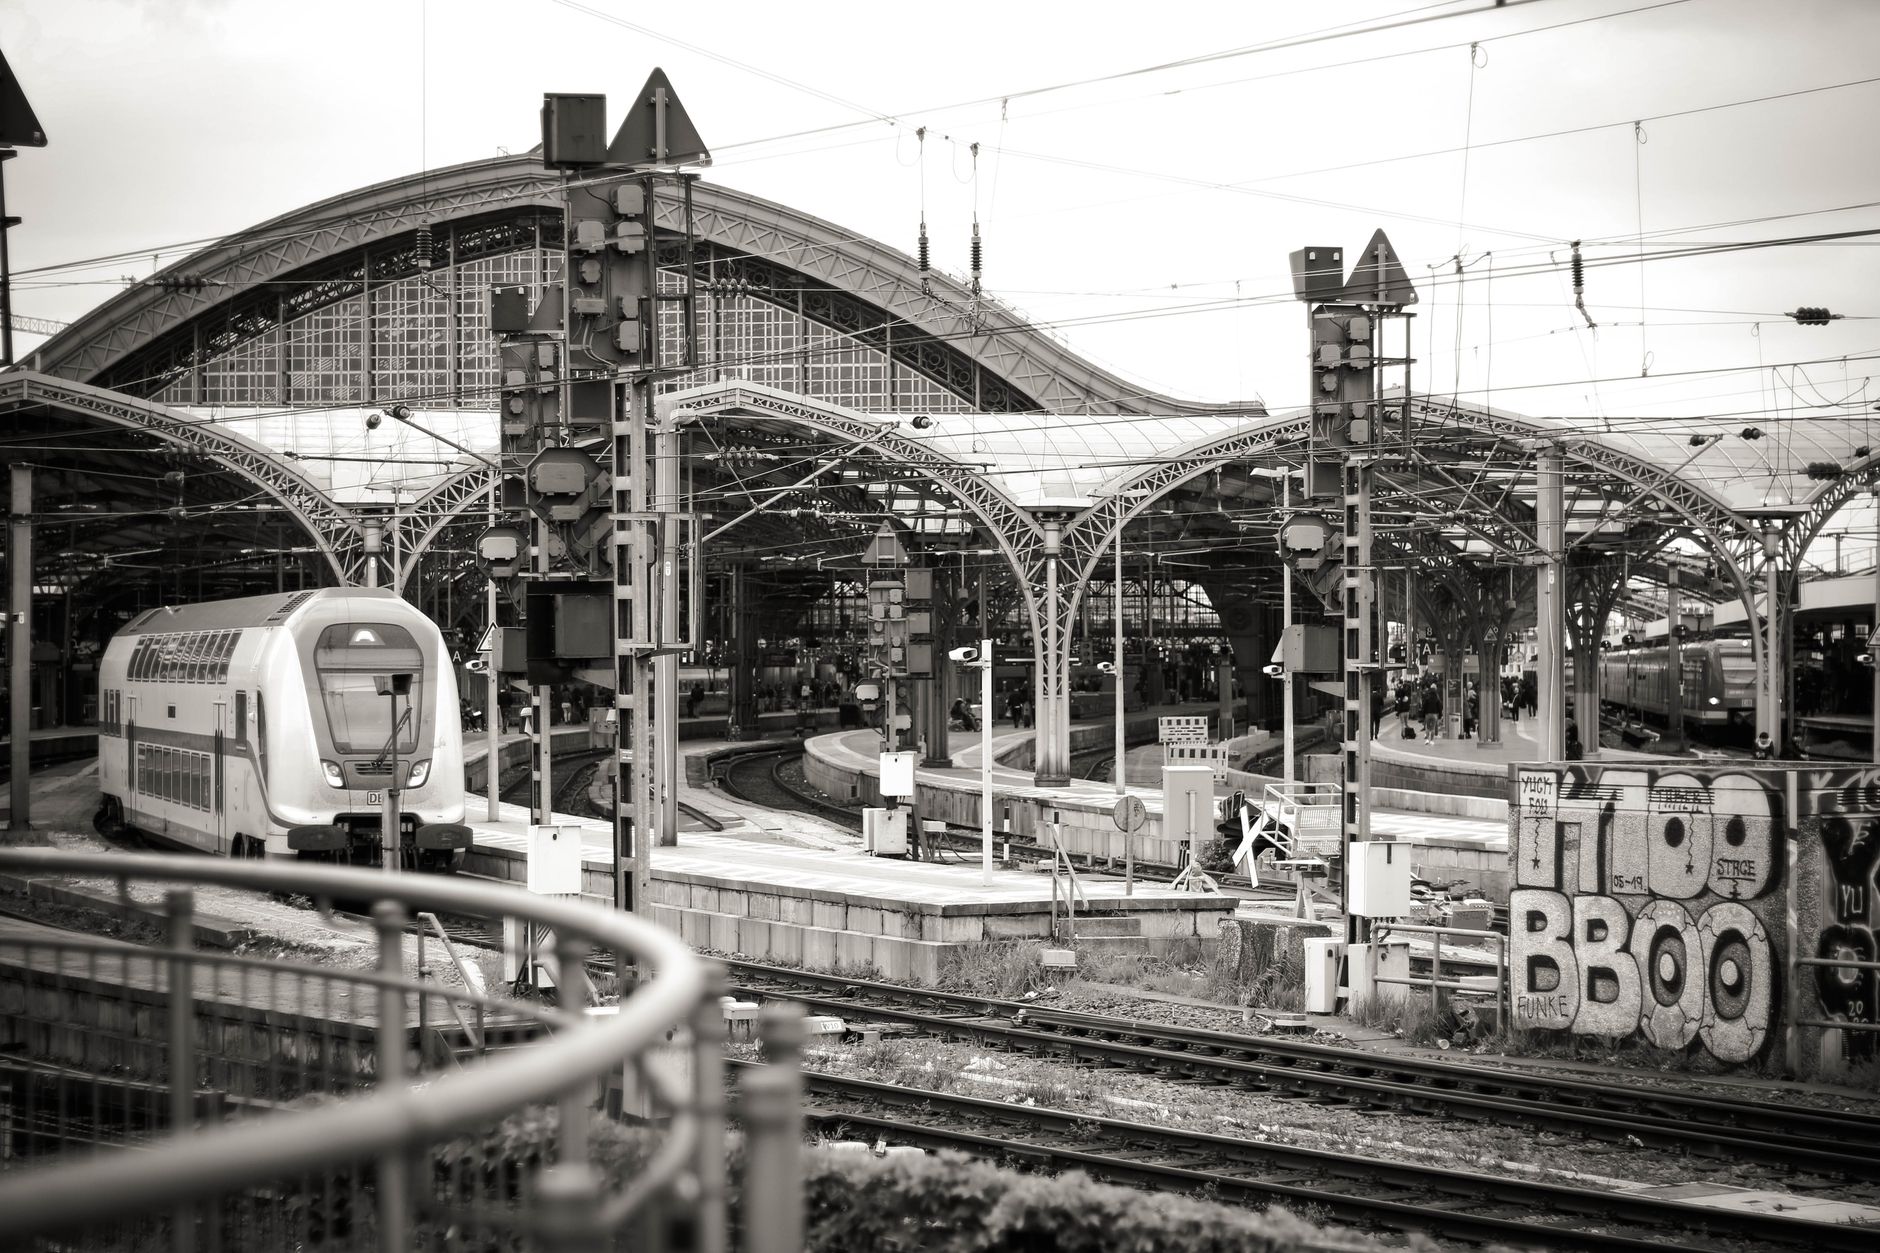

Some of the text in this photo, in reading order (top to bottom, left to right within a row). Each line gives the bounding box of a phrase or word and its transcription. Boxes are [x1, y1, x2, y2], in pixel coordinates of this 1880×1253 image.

[1422, 643, 1432, 655] A
[452, 650, 462, 662] A
[1517, 994, 1569, 1019] FUNKE
